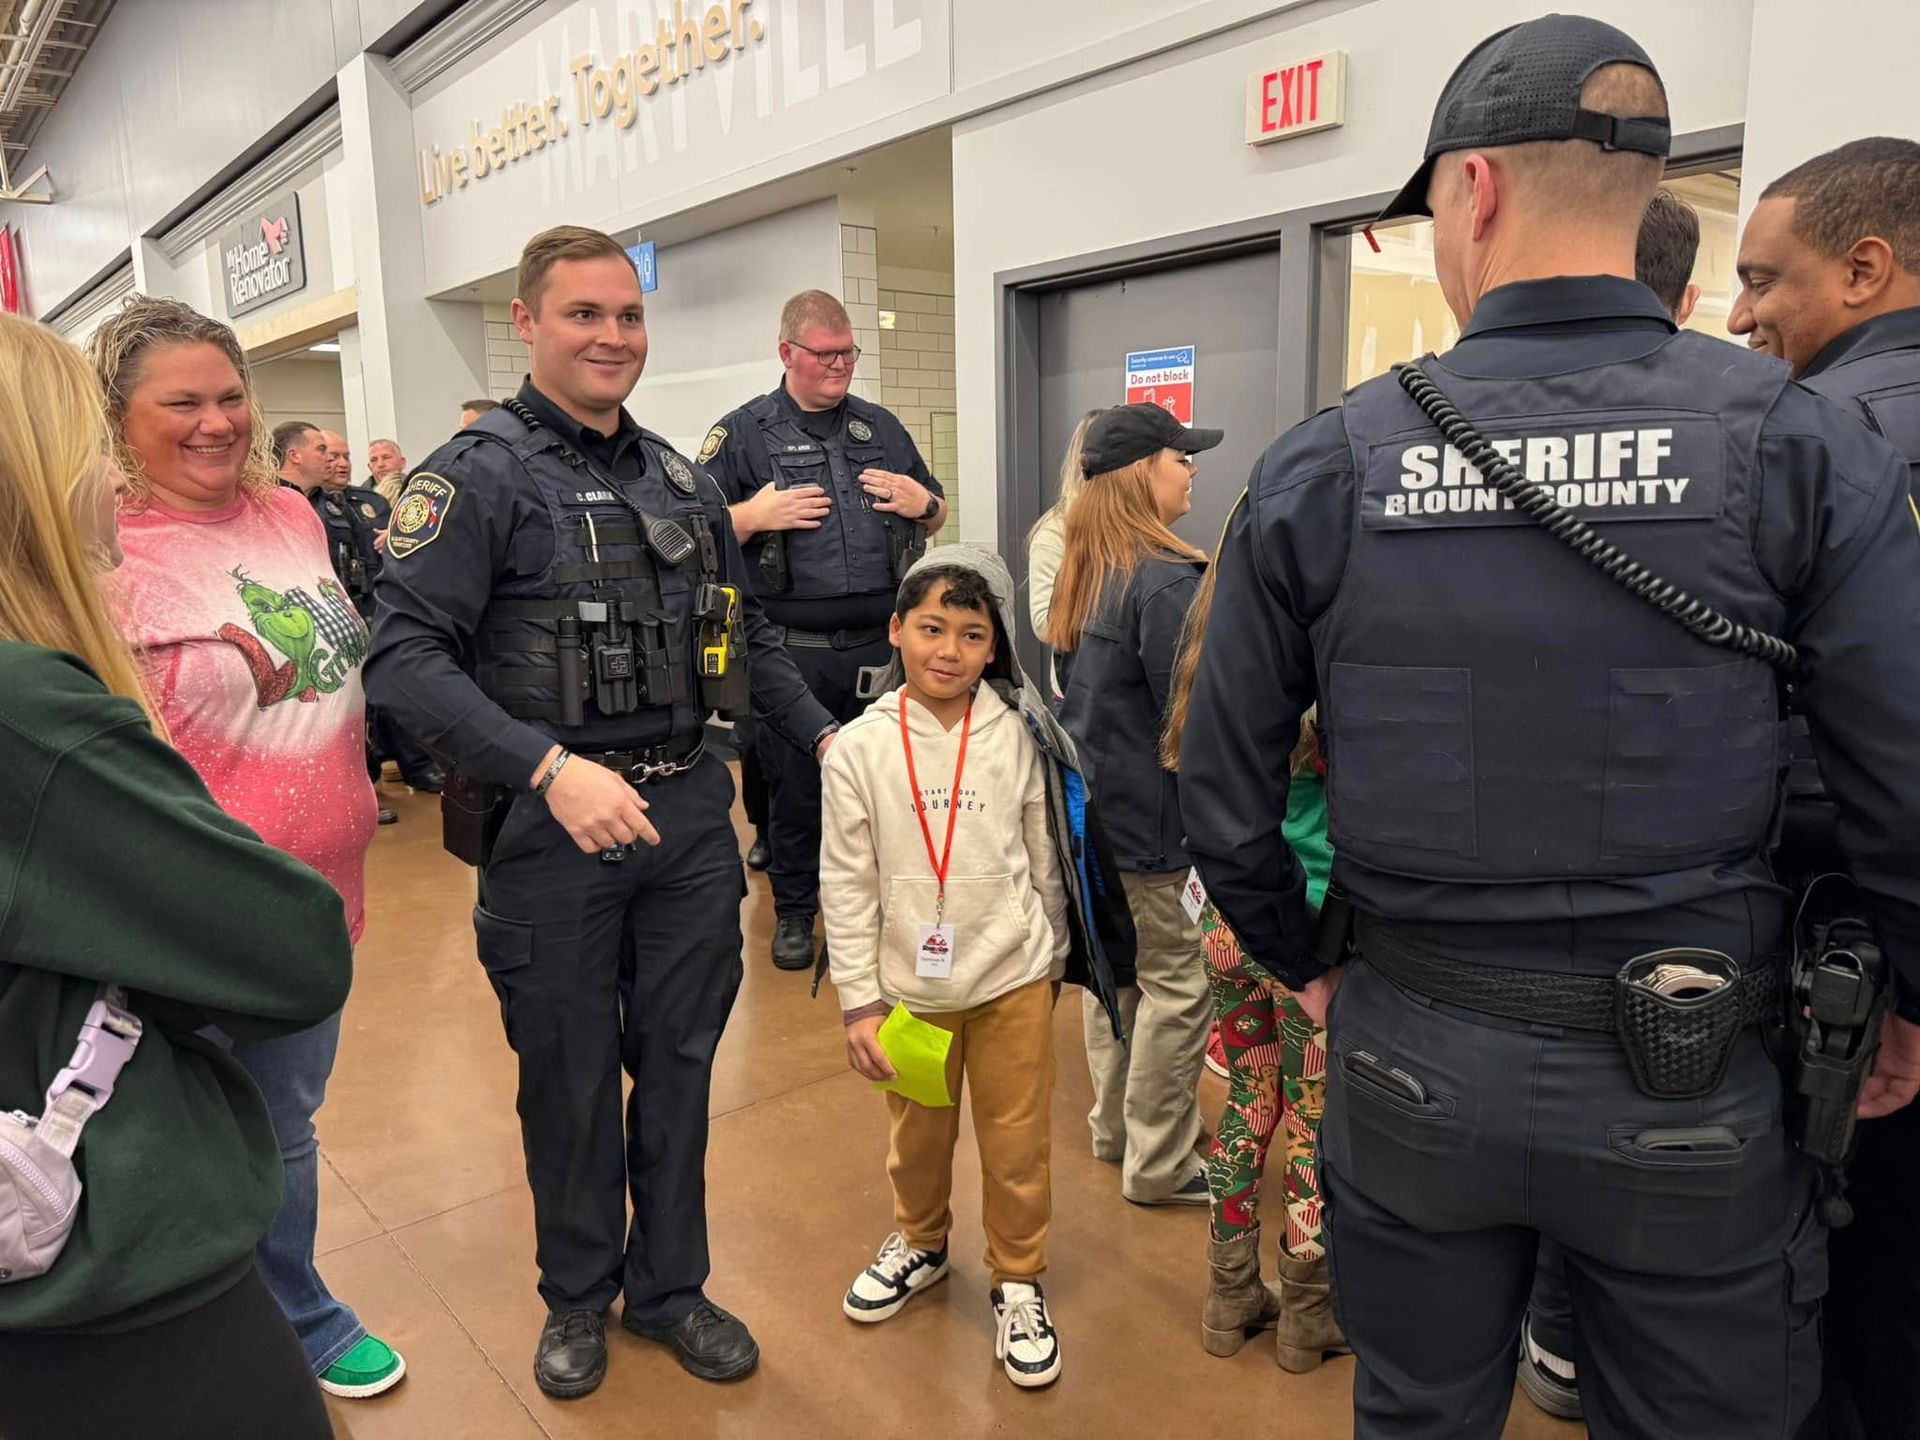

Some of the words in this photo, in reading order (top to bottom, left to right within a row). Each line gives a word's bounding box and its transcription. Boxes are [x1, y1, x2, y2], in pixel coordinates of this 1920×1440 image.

[420, 142, 469, 206] Live
[469, 91, 569, 179] better.
[569, 0, 765, 130] Together.
[1262, 60, 1323, 133] EXIT
[234, 241, 269, 277] Home
[231, 256, 290, 305] Renovator
[1131, 374, 1144, 385] Do
[1145, 372, 1161, 383] not
[1163, 369, 1189, 382] block
[1537, 478, 1690, 508] OUNTY
[958, 789, 976, 797] OUR
